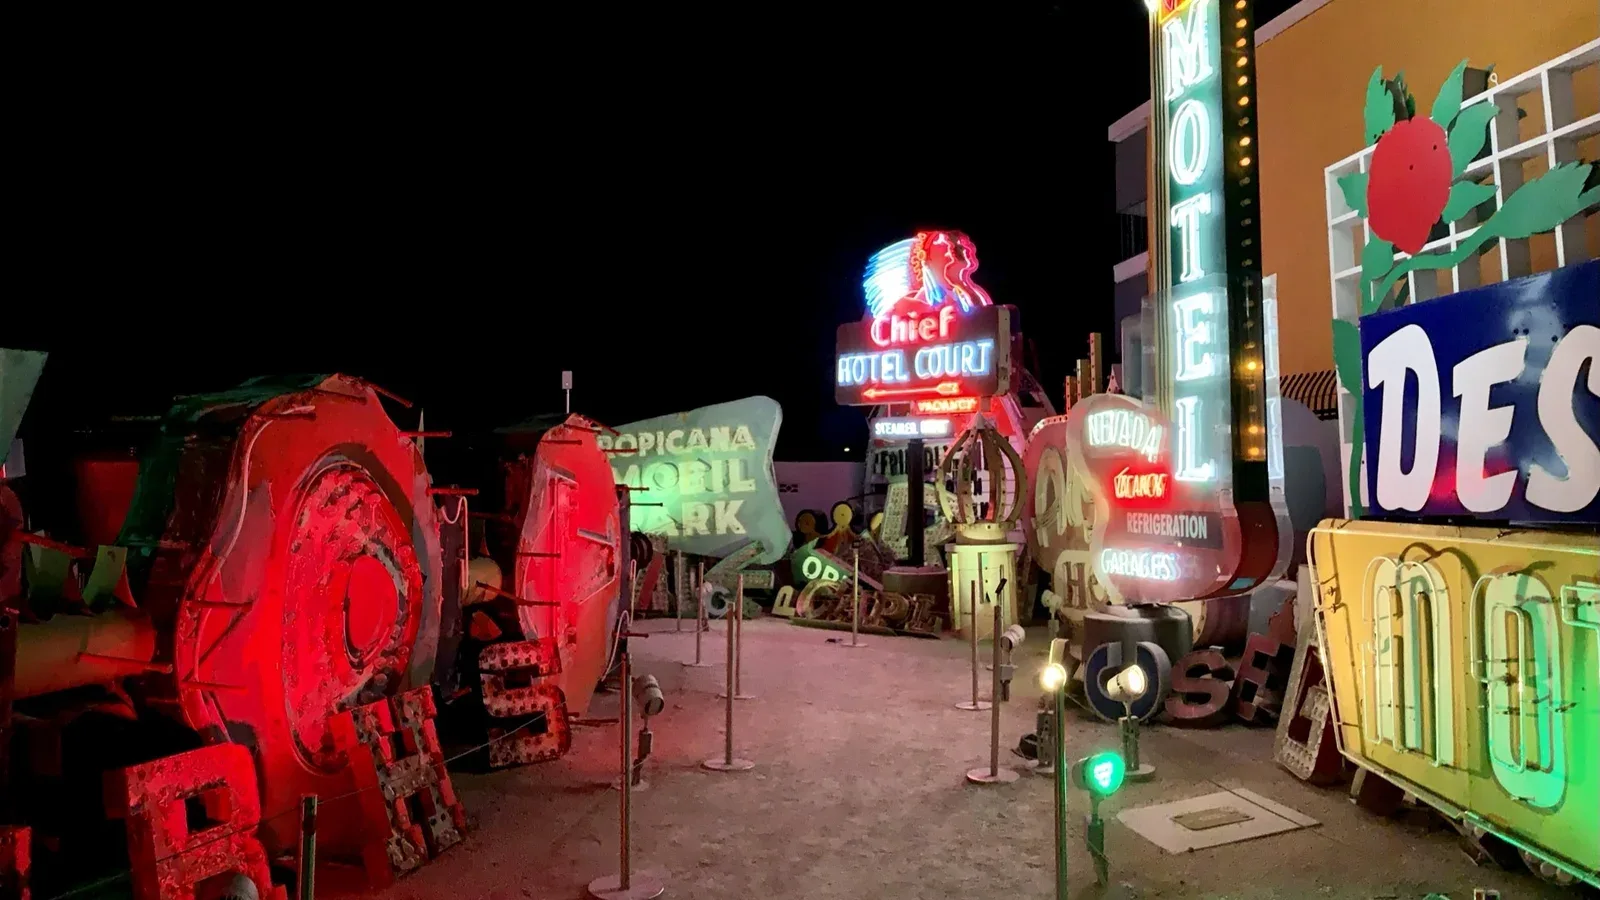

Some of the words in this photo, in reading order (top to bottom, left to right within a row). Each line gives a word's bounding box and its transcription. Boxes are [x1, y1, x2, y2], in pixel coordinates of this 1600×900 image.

[1162, 0, 1217, 484] MOTEL
[870, 305, 956, 347] Chief
[837, 352, 910, 387] HOTEL
[914, 338, 995, 380] COURT
[596, 424, 756, 459] ROPICANA
[1087, 409, 1164, 464] NEVADA
[613, 458, 757, 499] MOBIL
[629, 500, 747, 538] ARK
[1126, 511, 1209, 540] REFRIGERATION
